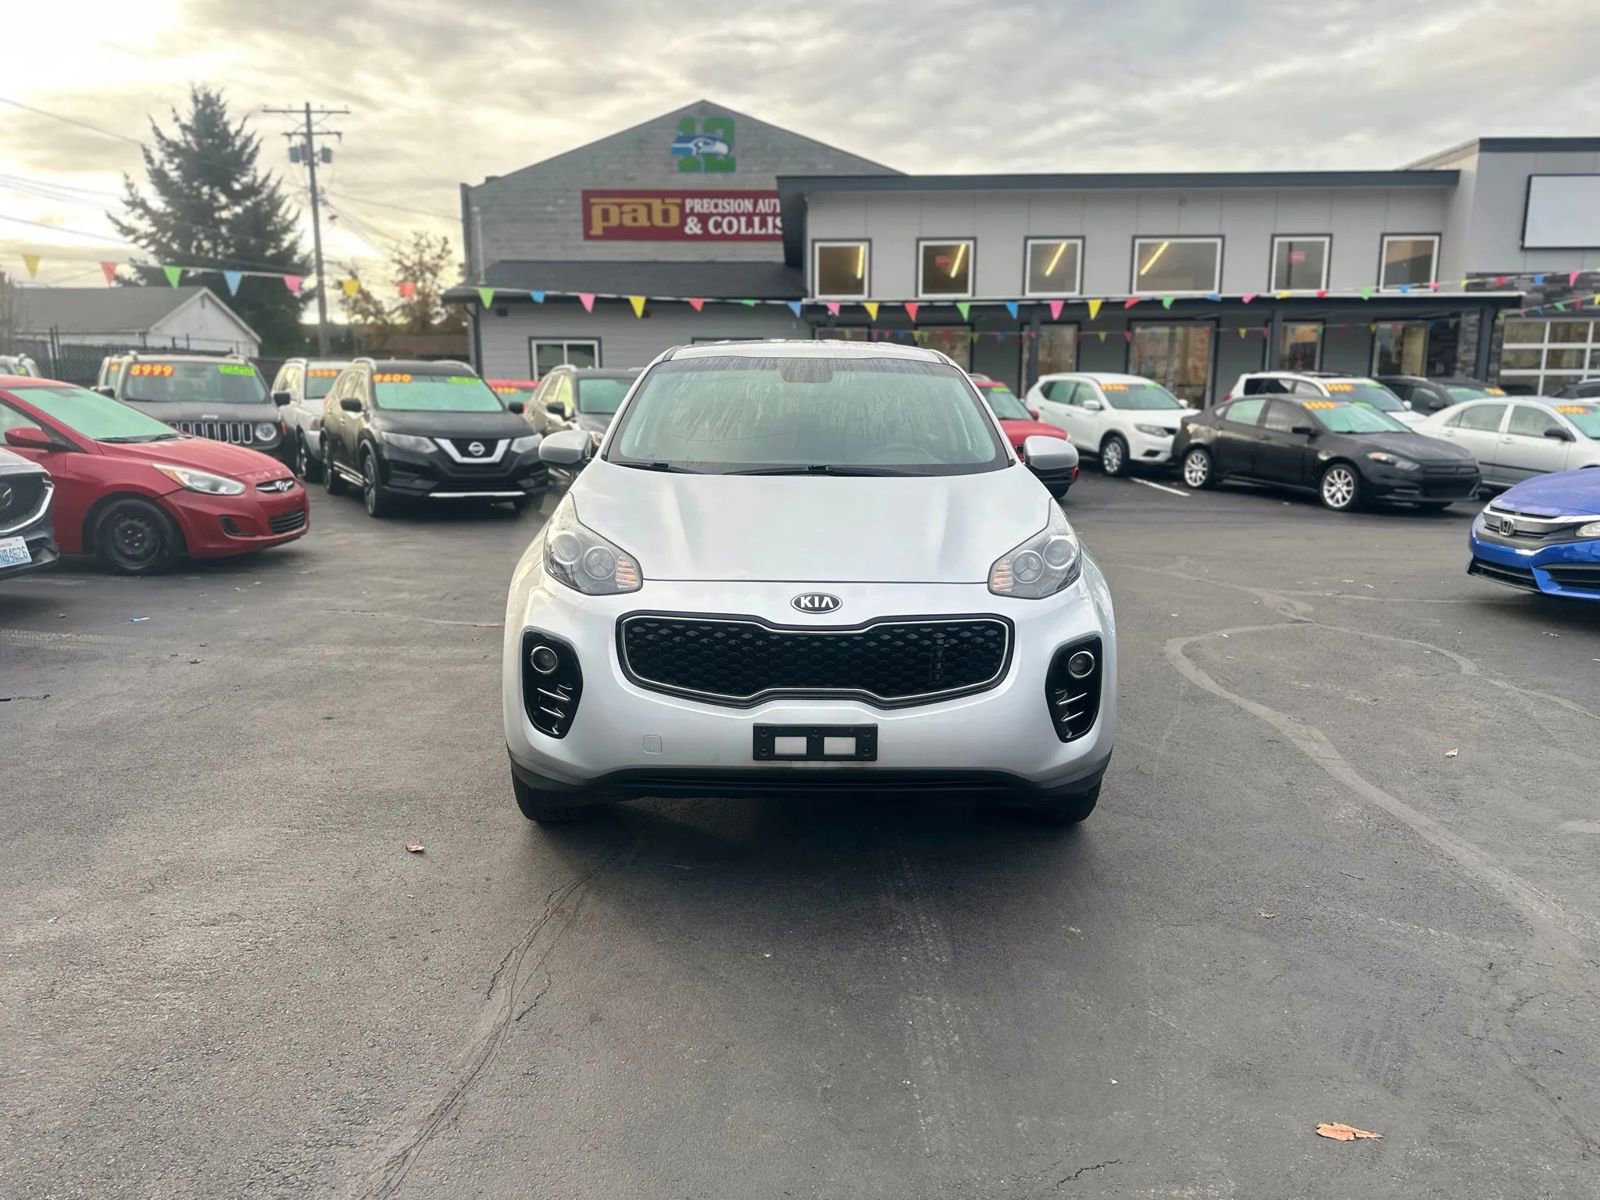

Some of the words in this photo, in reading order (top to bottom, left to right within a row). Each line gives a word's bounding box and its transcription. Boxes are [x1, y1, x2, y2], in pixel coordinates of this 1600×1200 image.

[684, 198, 753, 213] PRECISION
[589, 197, 682, 236] pab
[684, 216, 703, 235] &
[800, 596, 834, 608] KIA
